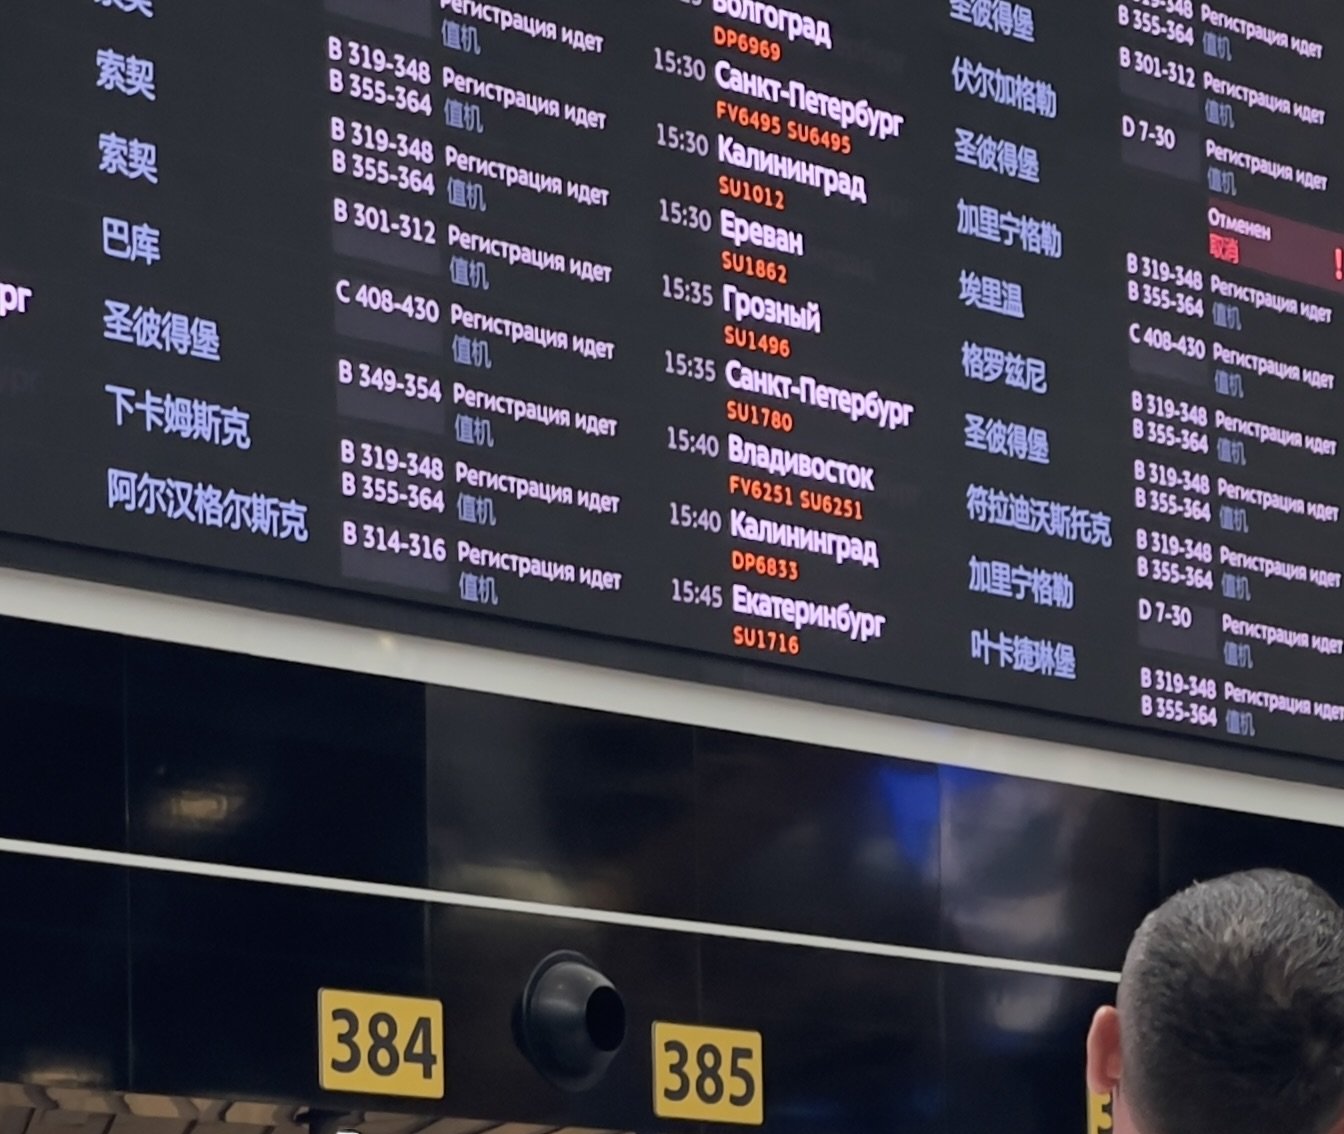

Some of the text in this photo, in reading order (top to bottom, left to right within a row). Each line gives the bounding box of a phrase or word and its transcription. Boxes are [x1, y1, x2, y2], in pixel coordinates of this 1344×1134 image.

[712, 0, 832, 50] Волгоград
[96, 48, 156, 101] 索契
[328, 35, 431, 86] B 319-348
[951, 55, 1057, 119] 伏尔加格勒
[329, 67, 433, 117] B 355-364
[442, 66, 607, 130] Регистрация идет
[654, 47, 904, 140] 15:30 Санкт-Петербург
[716, 100, 851, 154] FV6495 SU6495
[1122, 114, 1176, 150] D 7-30
[657, 122, 867, 204] 15:30 Калининград
[718, 175, 785, 210] SU1012
[102, 216, 161, 266] 巴库
[333, 197, 436, 245] B 301-312
[659, 198, 804, 256] 15:30 Ереван
[956, 197, 1062, 259] 加里宁格勒
[1207, 207, 1272, 241] Отменен
[335, 279, 440, 323] C 408-430
[662, 274, 821, 334] 15:35 Грозный
[958, 269, 1025, 319] 埃里温
[102, 299, 221, 361] 圣彼得堡
[338, 358, 442, 403] B 349-354
[665, 349, 914, 430] 15:35 Санкт-Петербург
[961, 340, 1048, 394] 格罗兹尼
[104, 384, 251, 450] 下卡姆斯克
[963, 413, 1050, 465] 圣彼得堡
[667, 425, 875, 491] 15:40 Владивосток
[107, 467, 309, 542] 阿尔汉格尔斯克
[729, 474, 863, 520] FV6251 SU6251
[966, 483, 1113, 548] 符拉迪沃斯托克
[342, 520, 447, 562] B 314-316
[670, 501, 880, 569] 15:40 Калининград
[457, 540, 622, 591] Регистрация идет
[731, 550, 798, 581] DP6833
[671, 578, 886, 642] 15:45 Екатеринбург
[733, 625, 799, 655] SU1716
[970, 628, 1077, 680] 叶卡捷琳堡
[329, 1007, 438, 1081] 384
[662, 1039, 757, 1108] 385
